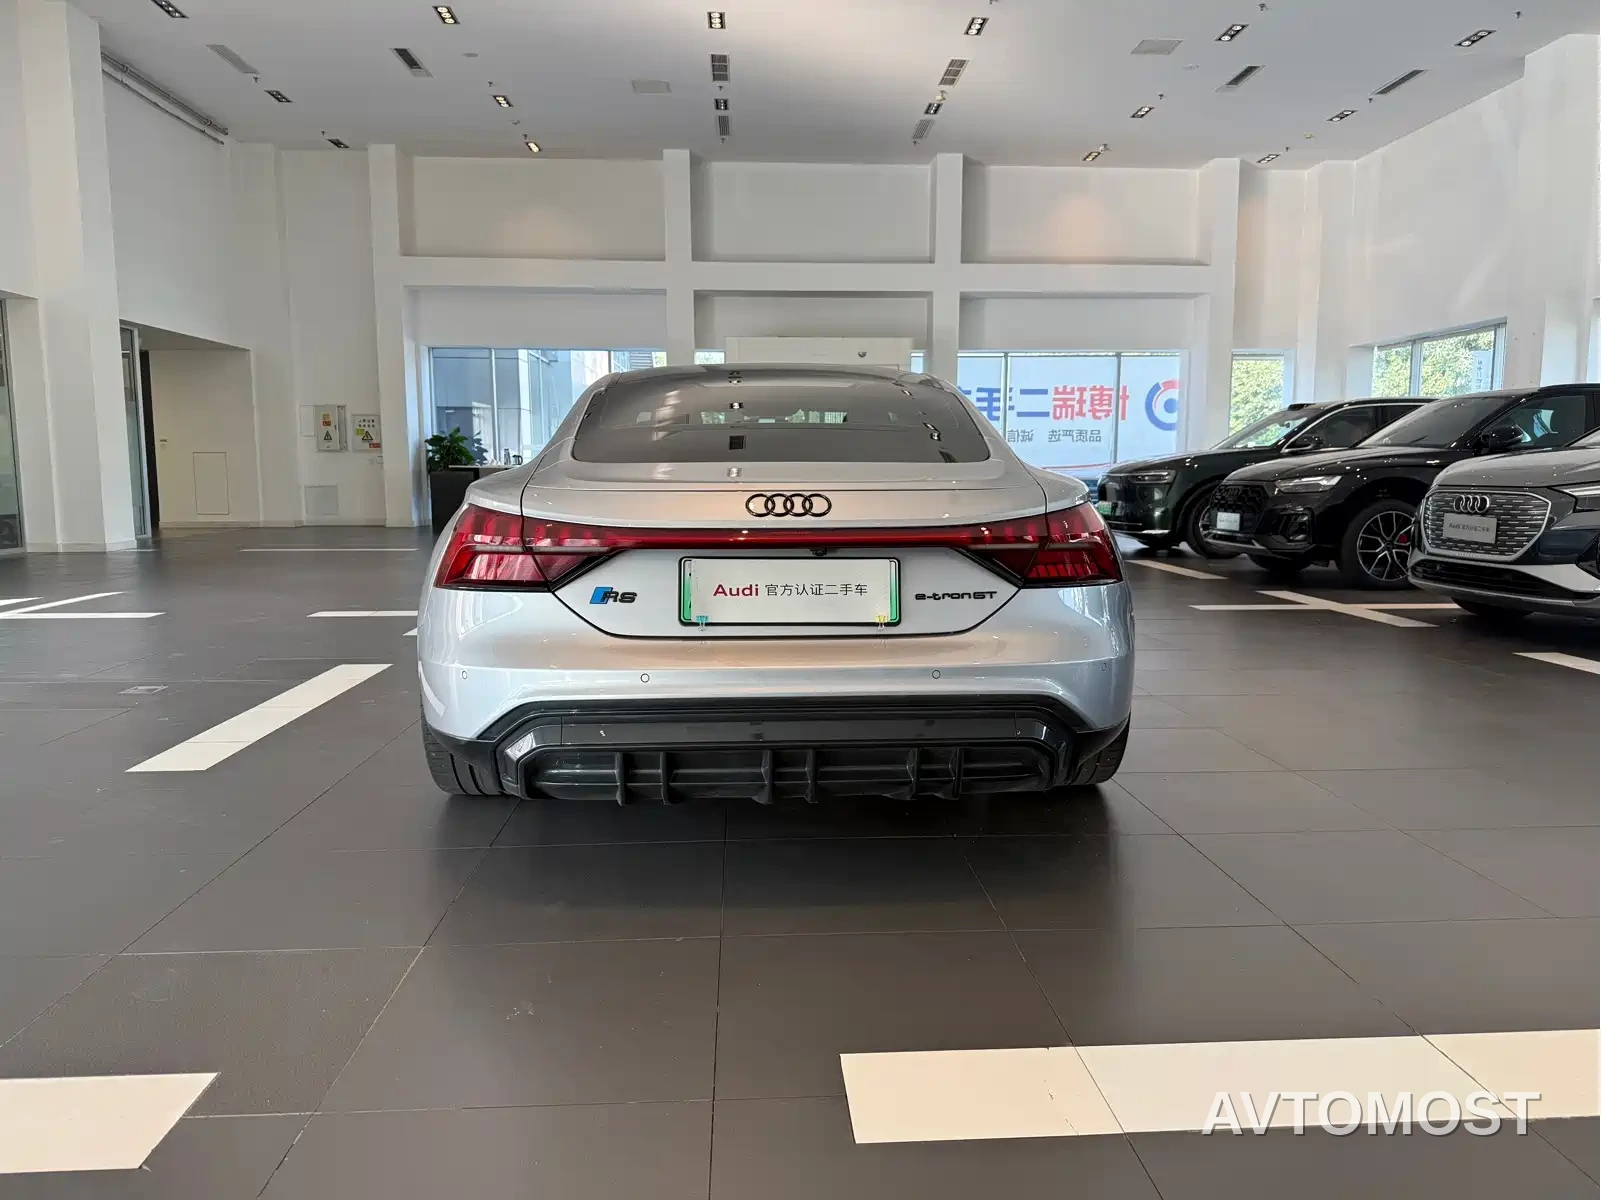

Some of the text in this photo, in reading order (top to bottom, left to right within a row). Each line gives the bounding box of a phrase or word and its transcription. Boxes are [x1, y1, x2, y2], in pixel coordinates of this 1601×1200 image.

[598, 590, 638, 604] RS
[713, 583, 868, 597] Audi 官方认证二手车
